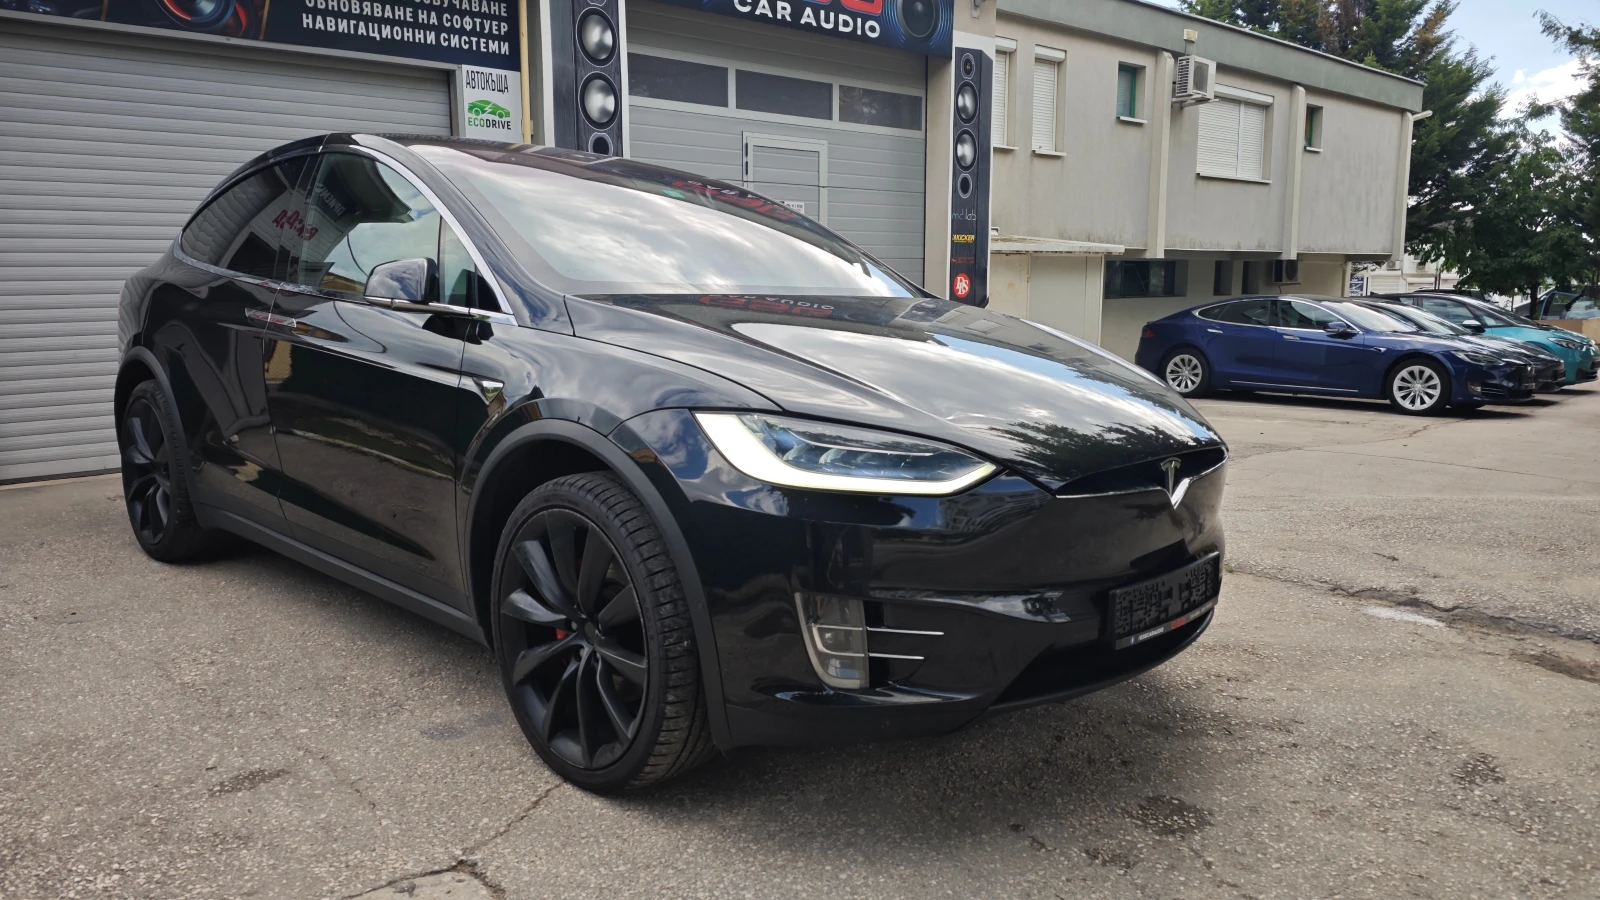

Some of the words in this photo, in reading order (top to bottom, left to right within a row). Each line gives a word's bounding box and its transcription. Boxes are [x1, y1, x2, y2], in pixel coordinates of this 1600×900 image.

[418, 9, 439, 26] НА
[443, 13, 508, 36] СОФТУЕР
[733, 0, 792, 22] CAR
[800, 7, 881, 38] AUDIO
[302, 13, 436, 45] НАВИГАЦИОННИ
[440, 32, 510, 56] СИСТЕМИ
[466, 69, 509, 94] АВТОКЪЩА
[468, 117, 511, 130] ECODRIVE
